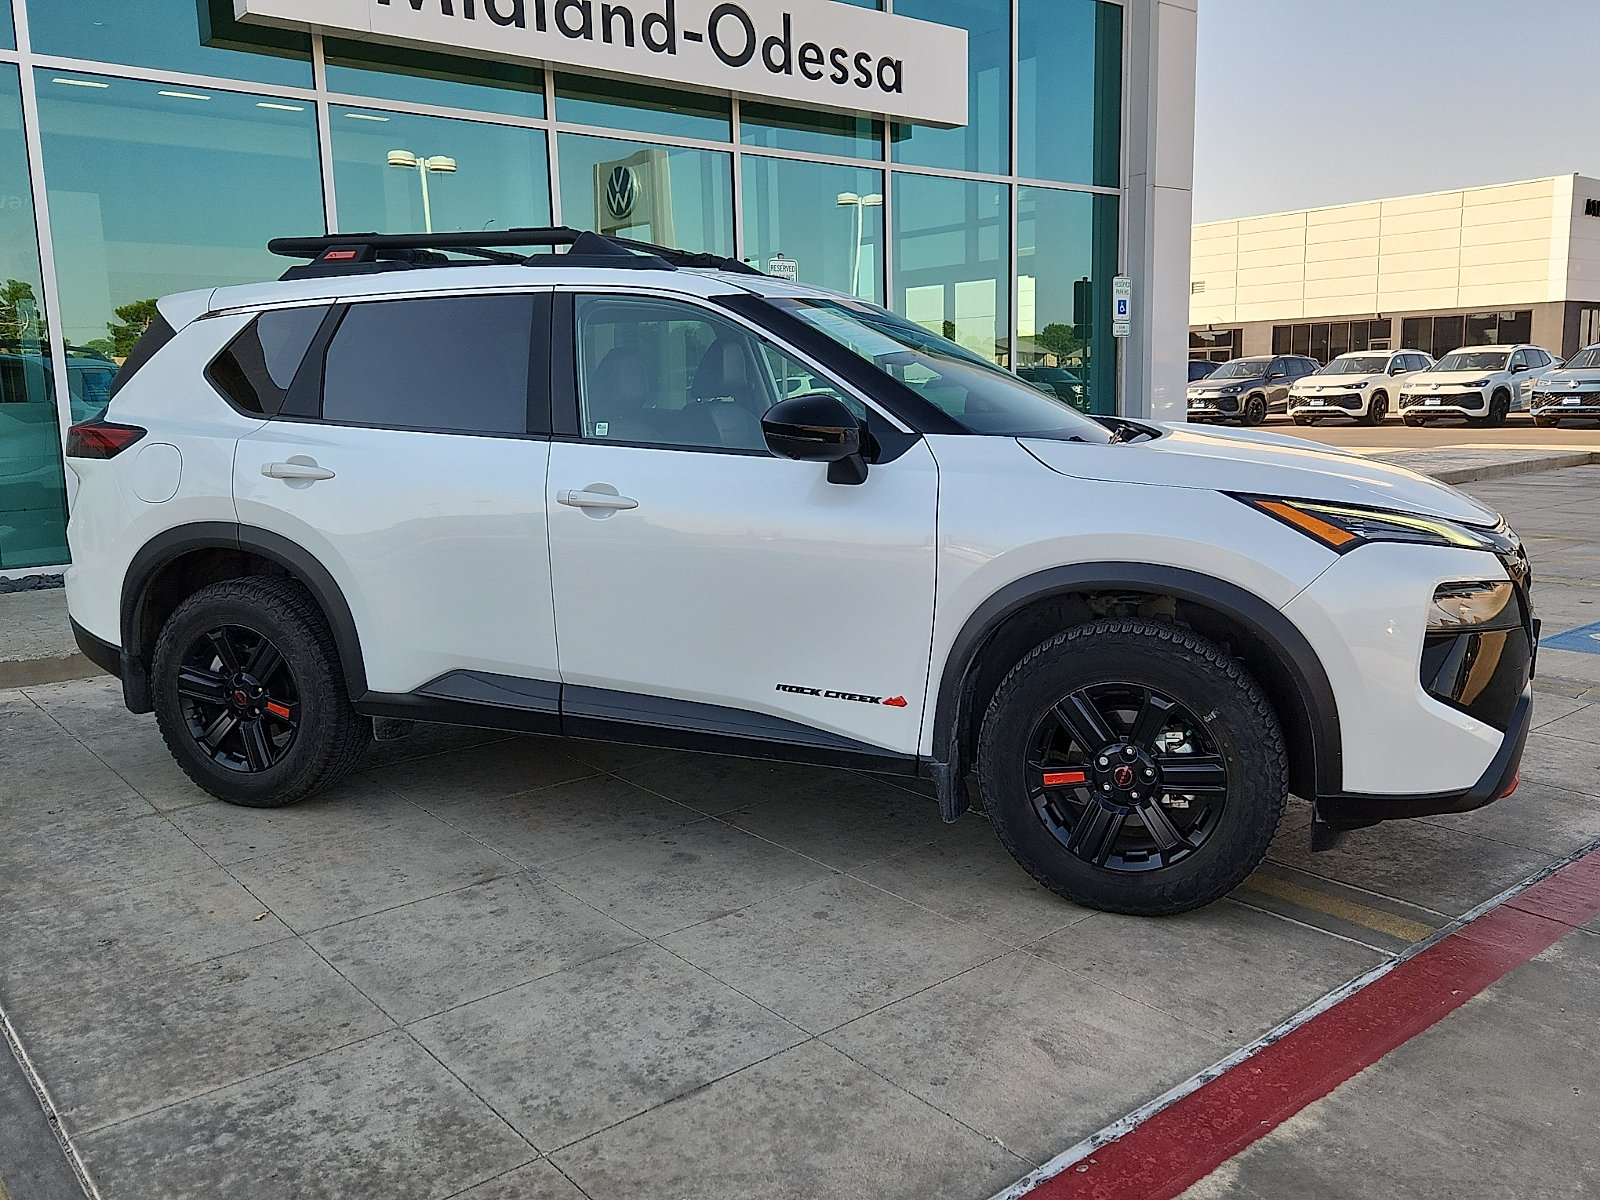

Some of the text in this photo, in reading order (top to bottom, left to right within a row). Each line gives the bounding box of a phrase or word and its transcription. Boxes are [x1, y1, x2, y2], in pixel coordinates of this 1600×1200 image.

[377, 0, 903, 94] dland-Odessa
[770, 264, 795, 272] RESERVED
[775, 683, 882, 705] ROCK CREEK
